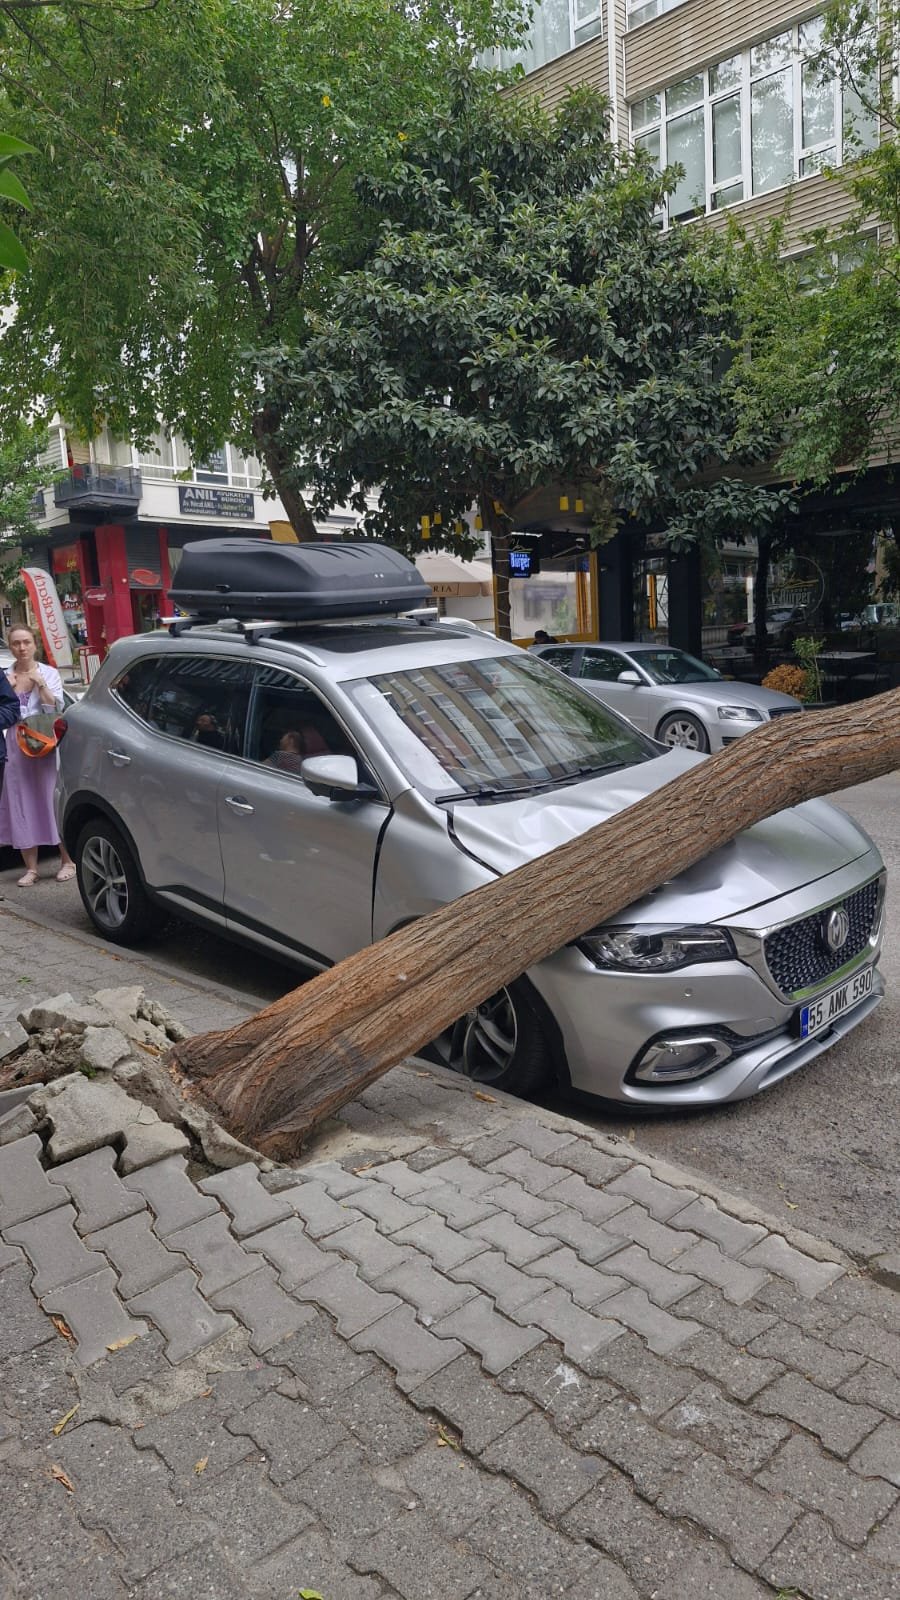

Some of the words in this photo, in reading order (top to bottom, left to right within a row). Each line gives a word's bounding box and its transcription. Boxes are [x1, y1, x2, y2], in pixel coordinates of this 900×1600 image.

[184, 488, 217, 501] ANIL
[809, 1002, 822, 1030] 55
[829, 985, 848, 1018] ANK
[853, 970, 871, 1000] 590
